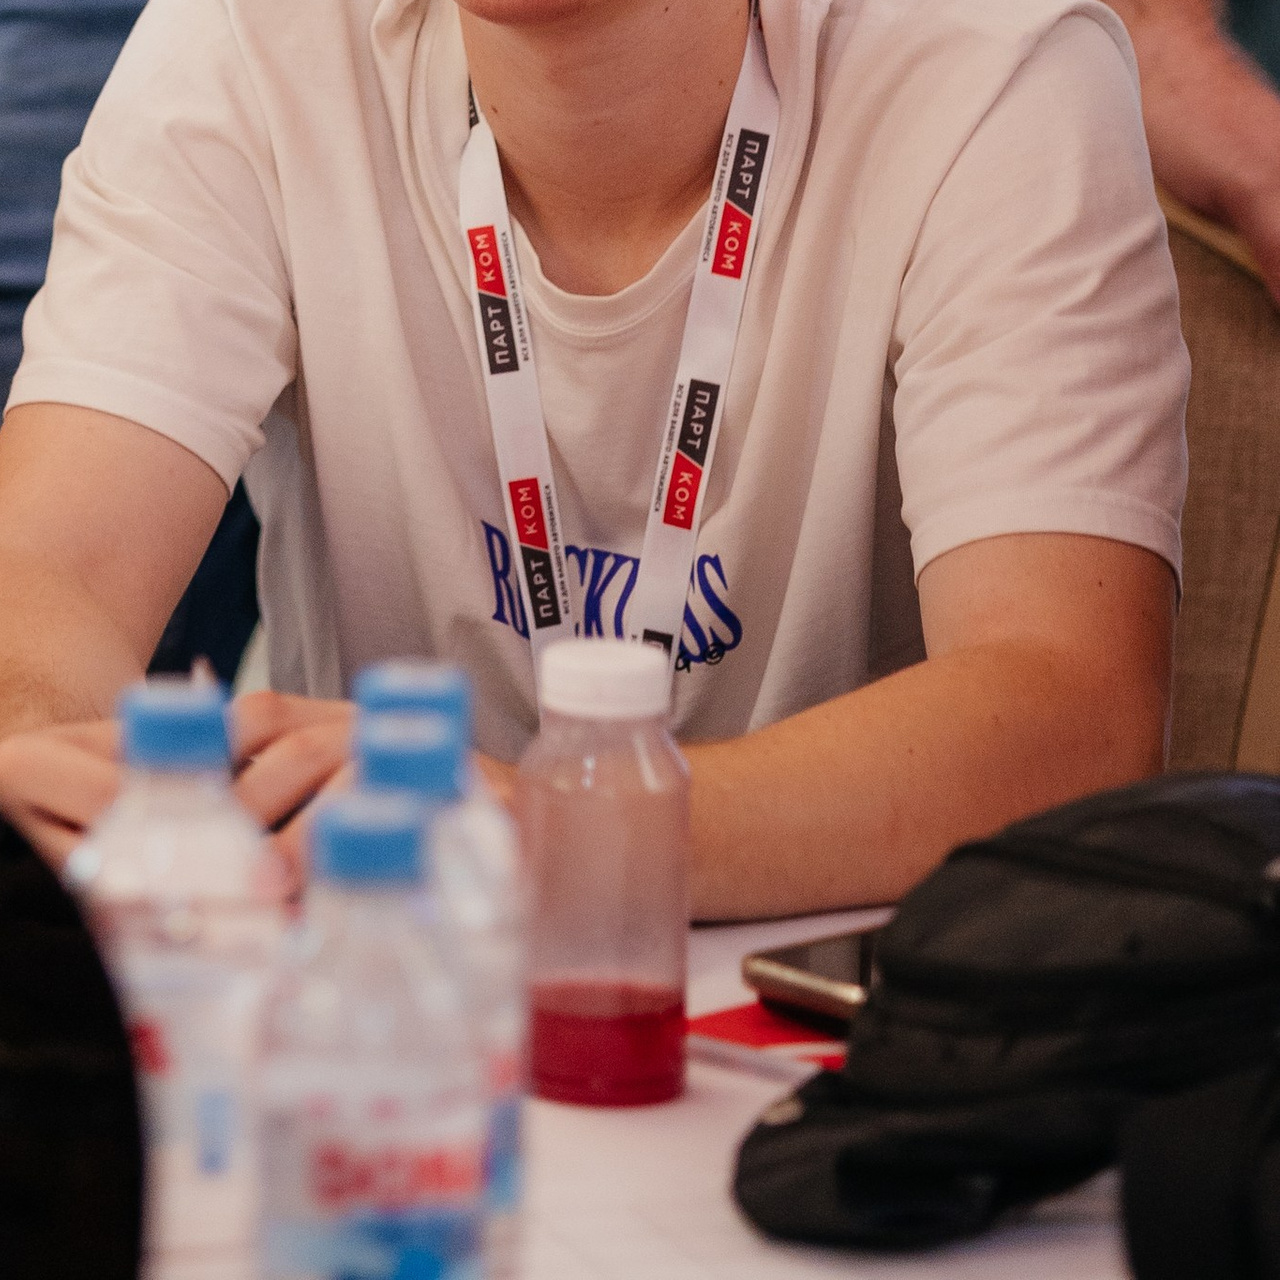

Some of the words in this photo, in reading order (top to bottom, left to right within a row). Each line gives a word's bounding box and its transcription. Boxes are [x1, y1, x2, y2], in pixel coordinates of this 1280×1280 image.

[734, 140, 759, 198] ПАРТ
[474, 233, 495, 282] КОМ
[720, 220, 742, 270] КОМ
[487, 304, 511, 364] ПАРТ
[686, 389, 710, 449] ПАРТ
[517, 486, 537, 535] КОМ
[671, 471, 693, 520] КОМ
[530, 556, 554, 618] ПАРТ
